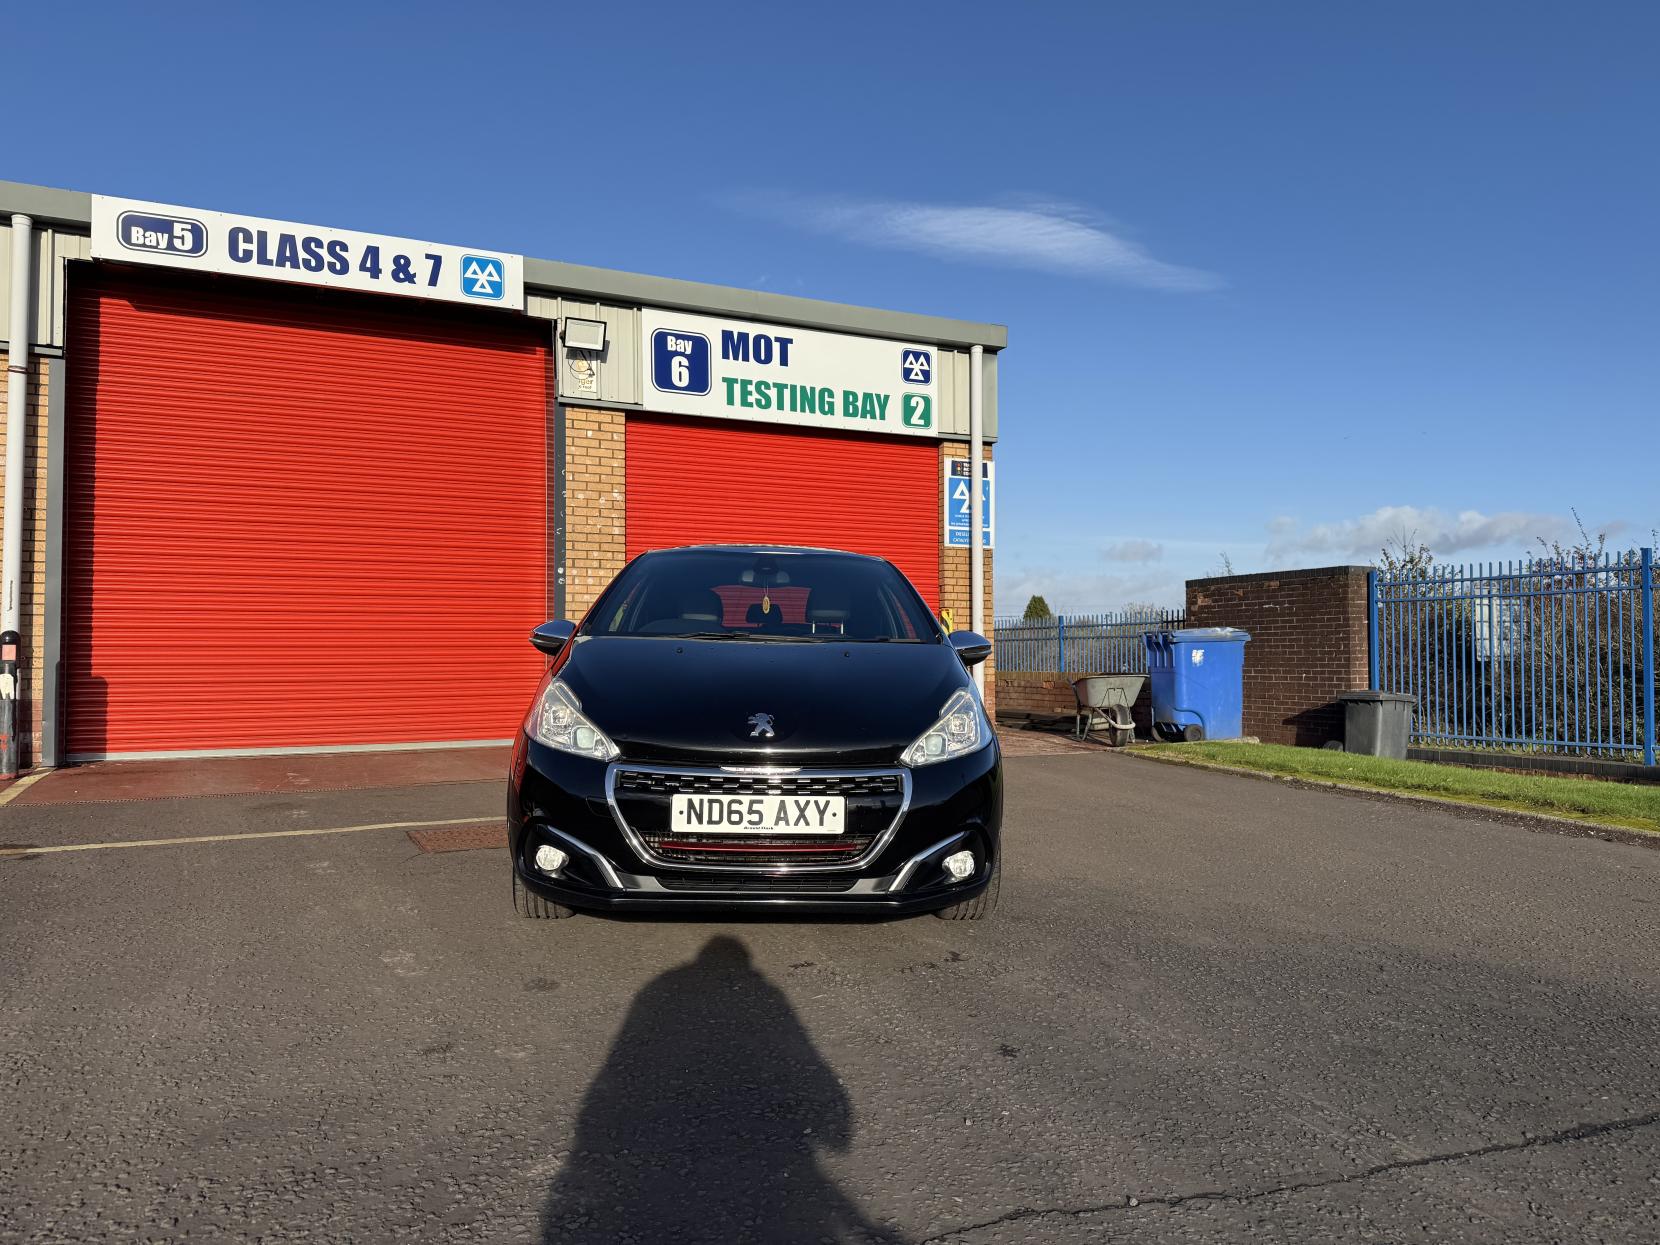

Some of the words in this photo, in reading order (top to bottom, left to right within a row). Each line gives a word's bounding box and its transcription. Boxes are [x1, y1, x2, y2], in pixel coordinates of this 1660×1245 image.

[131, 226, 169, 250] Bay
[172, 222, 193, 251] 5
[228, 226, 350, 276] CLASS
[358, 245, 383, 280] 4
[390, 254, 417, 285] &
[424, 253, 443, 287] 7
[667, 335, 693, 355] Bay
[721, 329, 794, 367] MOT
[671, 355, 690, 388] 6
[721, 376, 835, 417] TESTING
[842, 389, 891, 421] BAY
[910, 397, 926, 426] 2
[686, 798, 764, 826] ND65
[773, 799, 831, 827] AXY
